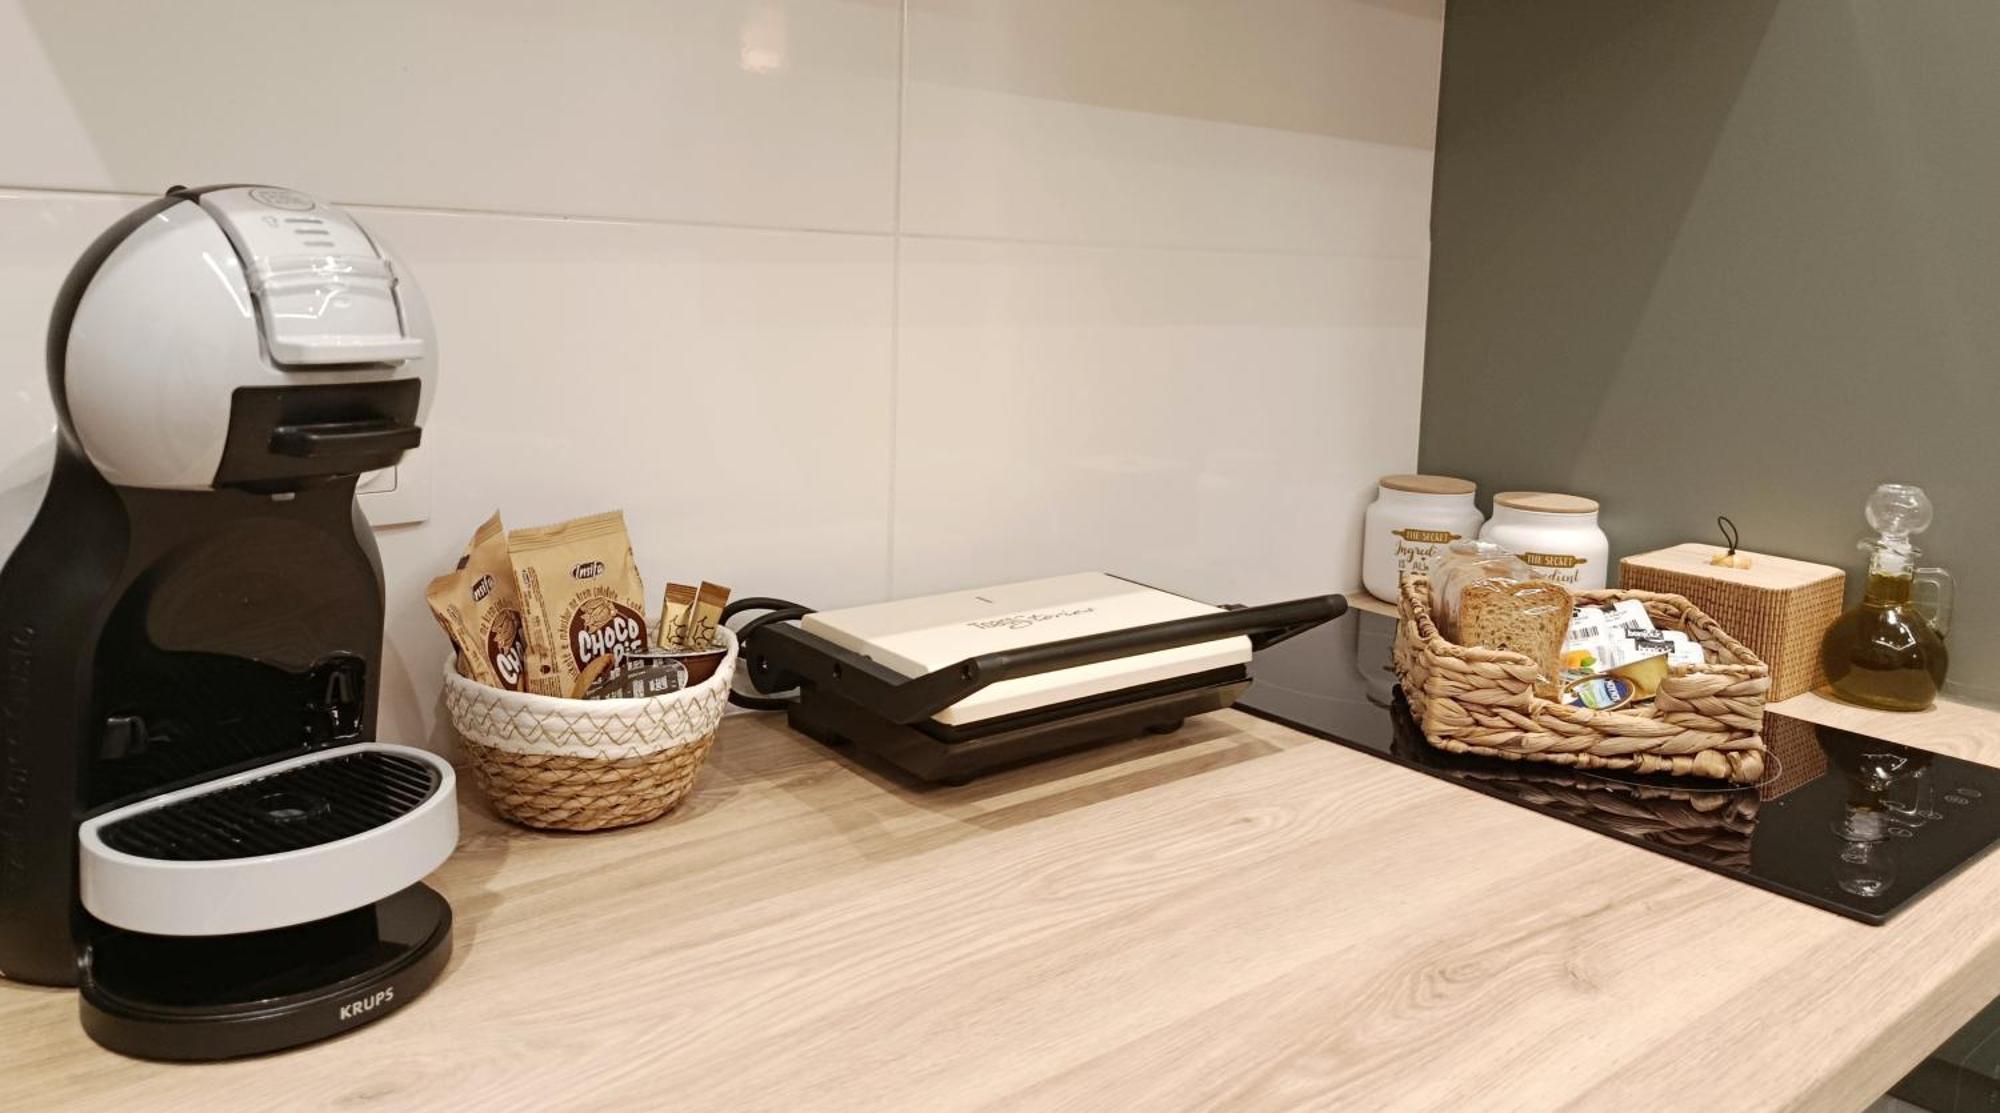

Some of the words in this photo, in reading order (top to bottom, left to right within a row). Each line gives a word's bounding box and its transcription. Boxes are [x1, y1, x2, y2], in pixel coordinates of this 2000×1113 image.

[1422, 531, 1449, 543] SECRET
[1545, 555, 1574, 568] SECRET
[578, 616, 640, 663] CHOCO
[340, 985, 394, 1020] KRUPS
